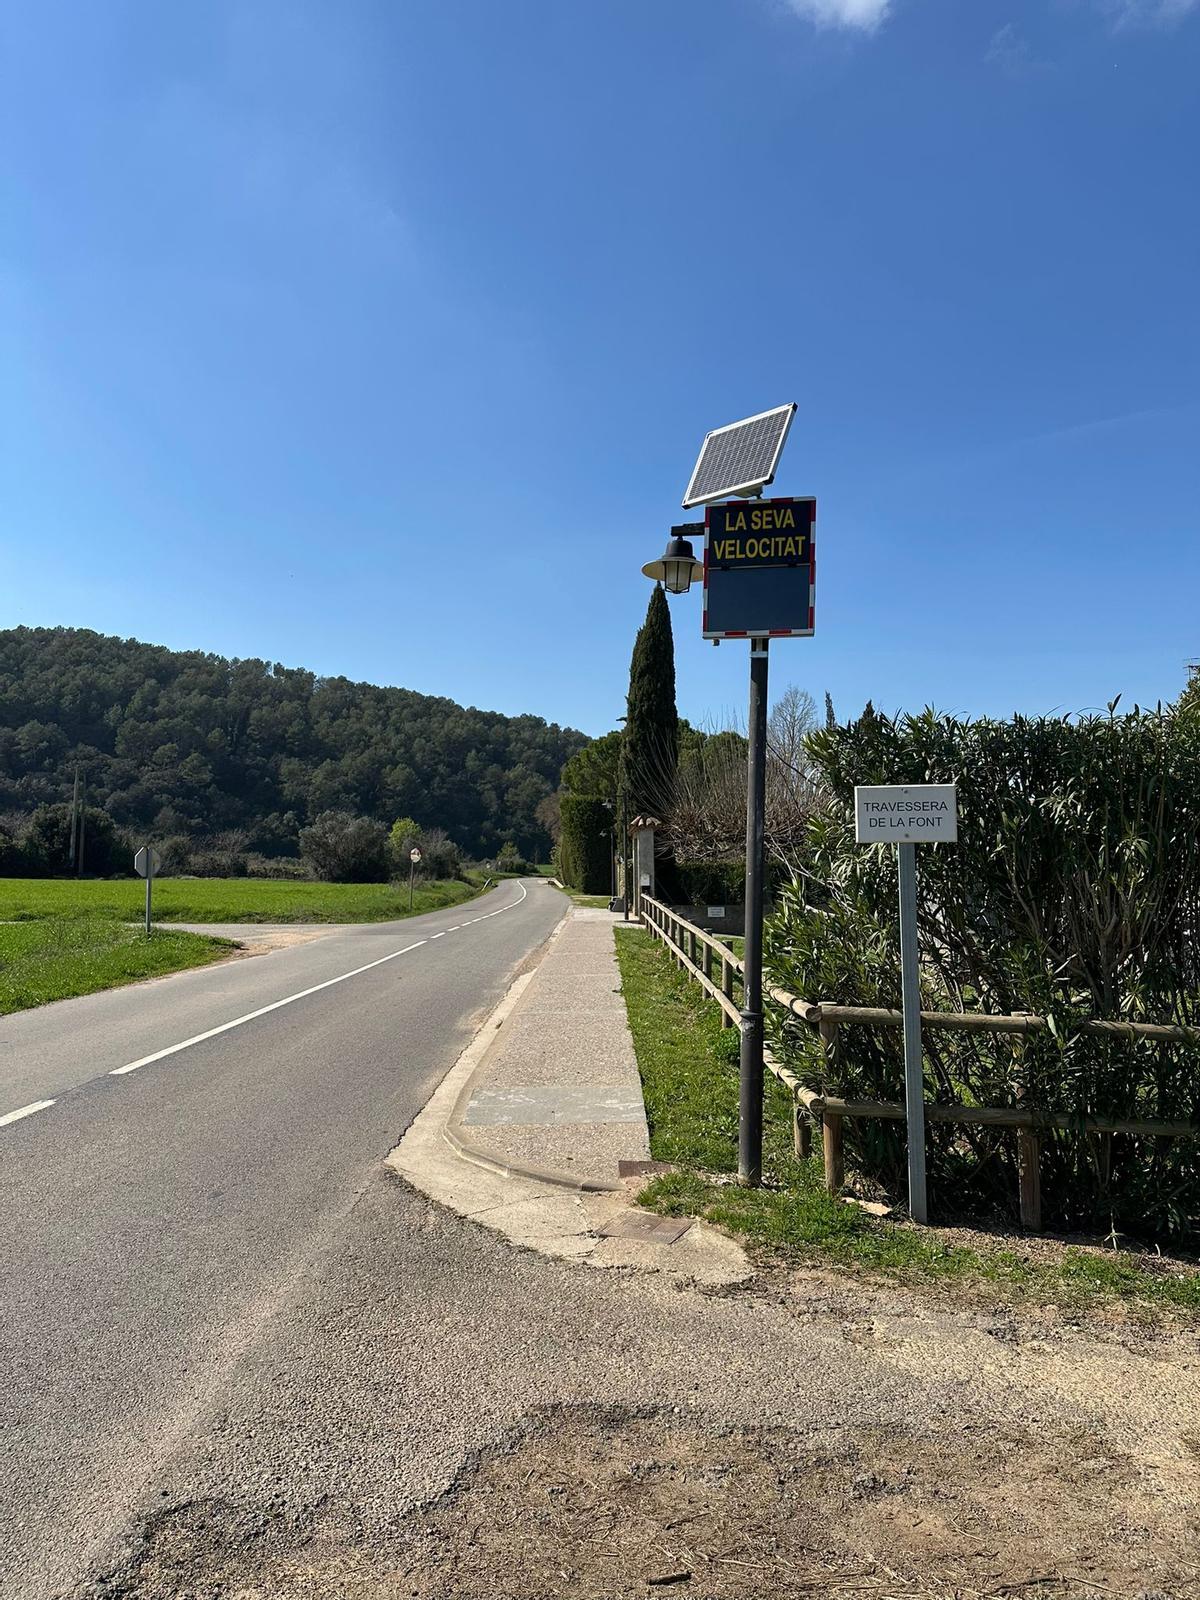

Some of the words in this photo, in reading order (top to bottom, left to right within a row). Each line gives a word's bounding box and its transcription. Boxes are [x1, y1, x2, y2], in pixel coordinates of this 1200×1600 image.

[725, 512, 747, 531] LA
[751, 509, 795, 530] SEVA
[714, 536, 806, 560] VELOCITAT
[864, 801, 948, 812] TRAVESSERA
[869, 817, 886, 828] DE
[890, 817, 905, 827] LA
[909, 817, 943, 827] FONT
